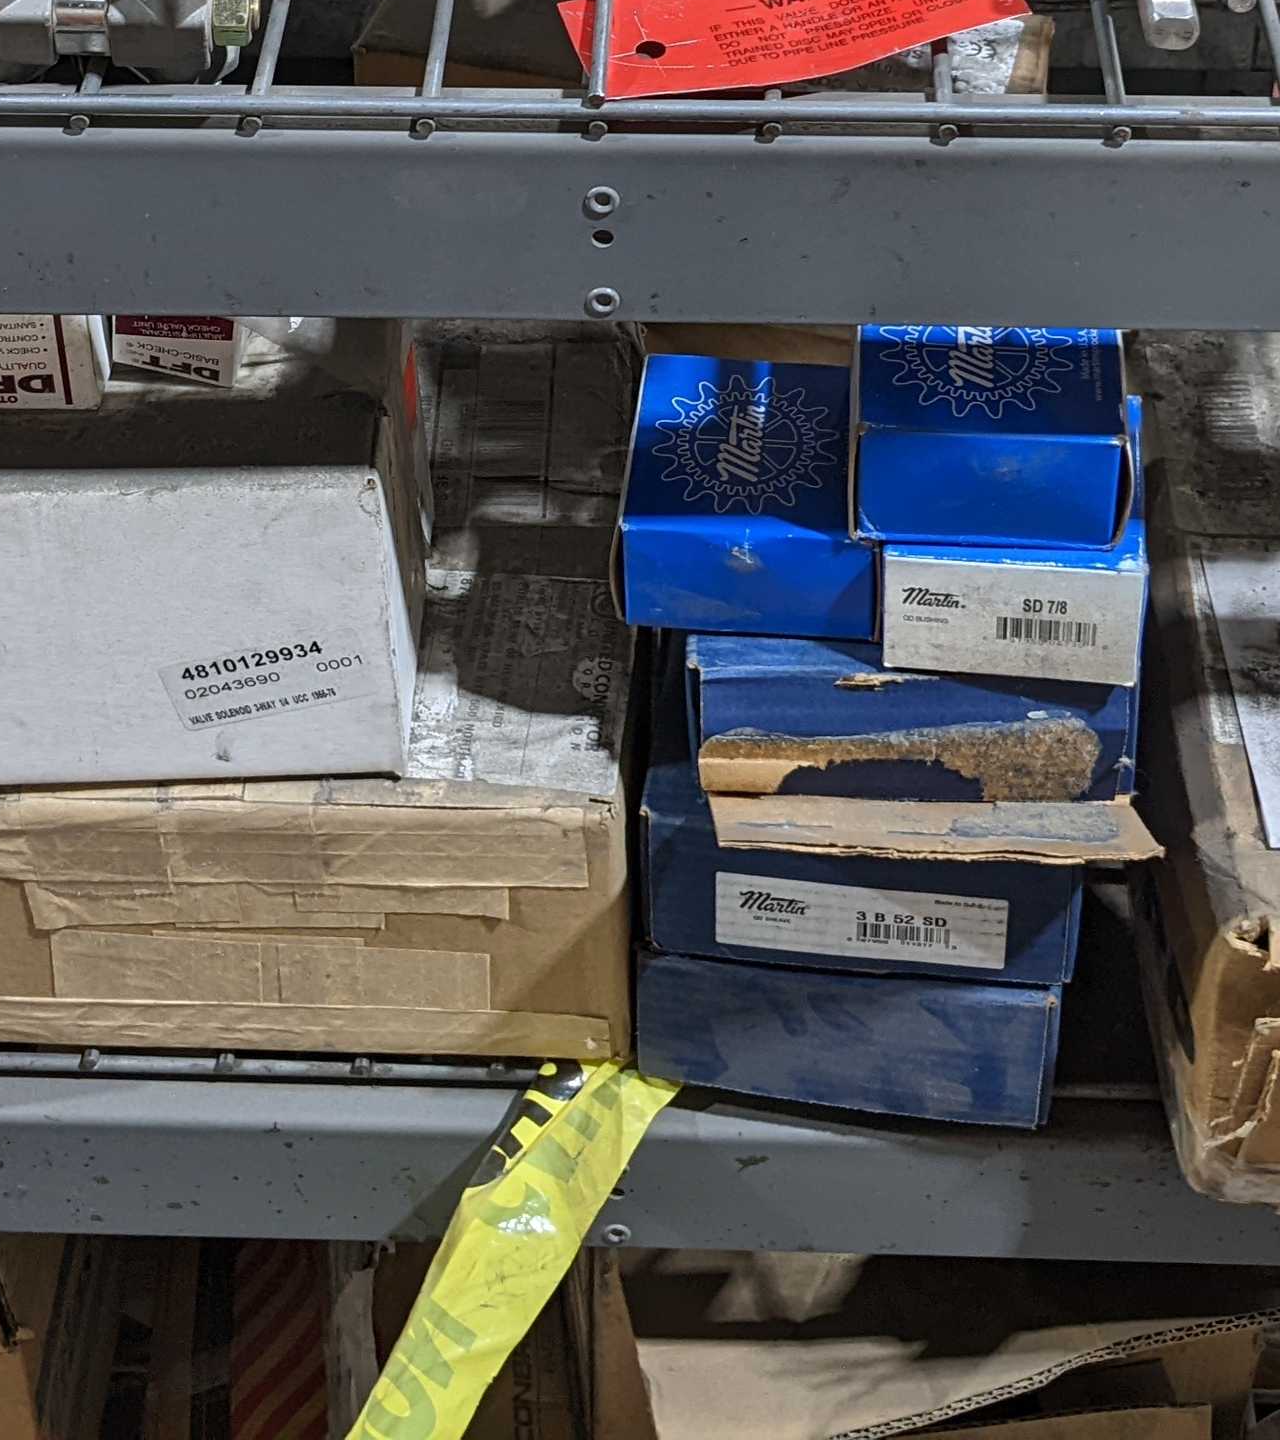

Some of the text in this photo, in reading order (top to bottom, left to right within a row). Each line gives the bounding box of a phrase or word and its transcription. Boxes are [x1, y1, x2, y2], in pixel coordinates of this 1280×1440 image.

[713, 27, 765, 42] EITHER
[769, 24, 779, 33] A
[783, 12, 838, 30] HANDLE
[720, 40, 740, 50] DO
[758, 32, 786, 43] NOT
[805, 7, 892, 35] PRESSURIZE
[723, 43, 784, 59] TRAINED
[788, 35, 820, 48] DISC
[826, 28, 853, 41] MAY
[858, 16, 897, 32] OPEN
[902, 9, 923, 20] OR
[735, 17, 766, 30] THIS
[728, 56, 758, 68] DUE
[761, 51, 780, 62] TO
[783, 46, 815, 60] PIPE
[818, 38, 848, 52] LINE
[8, 346, 41, 355] CHECK
[148, 355, 220, 383] DFT
[717, 405, 766, 481] Martin
[1022, 598, 1068, 615] SD 7/8
[181, 641, 323, 681] 4810129934
[184, 654, 364, 700] 02043690 0001
[188, 711, 215, 726] VALVE
[216, 704, 253, 721] SOLENOID
[292, 692, 310, 705] UCC
[739, 890, 806, 915] Martin
[856, 911, 947, 928] 3 B 52 SD
